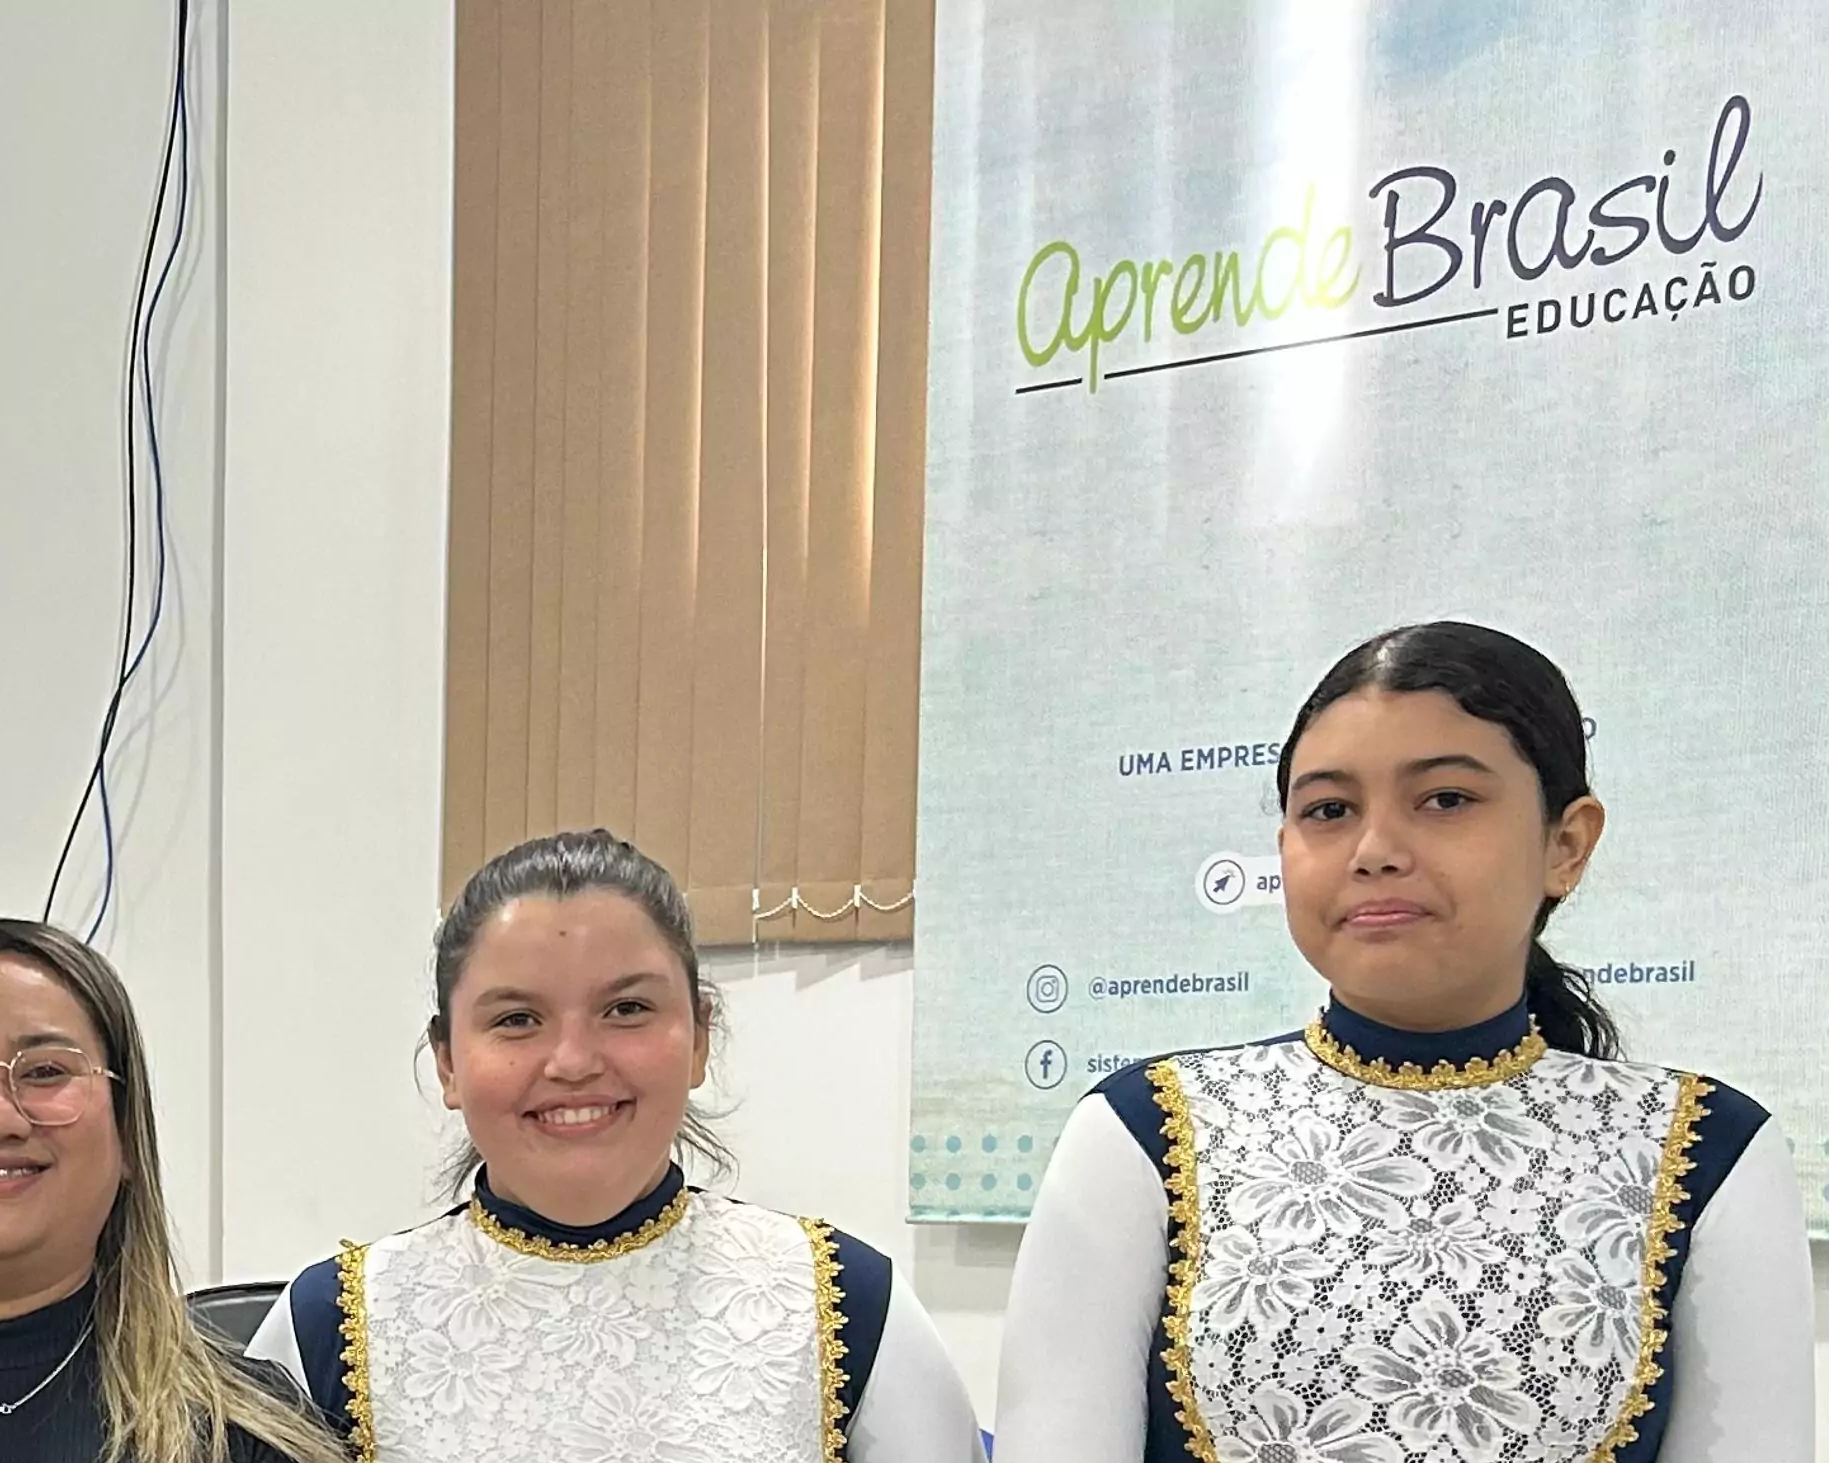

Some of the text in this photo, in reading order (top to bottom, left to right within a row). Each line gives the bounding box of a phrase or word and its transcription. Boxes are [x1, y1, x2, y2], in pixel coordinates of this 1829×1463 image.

[1505, 260, 1757, 339] EDUCAÇÃO
[1119, 742, 1280, 777] UMA EMPRES
[1088, 972, 1249, 1000] @aprendebrasil
